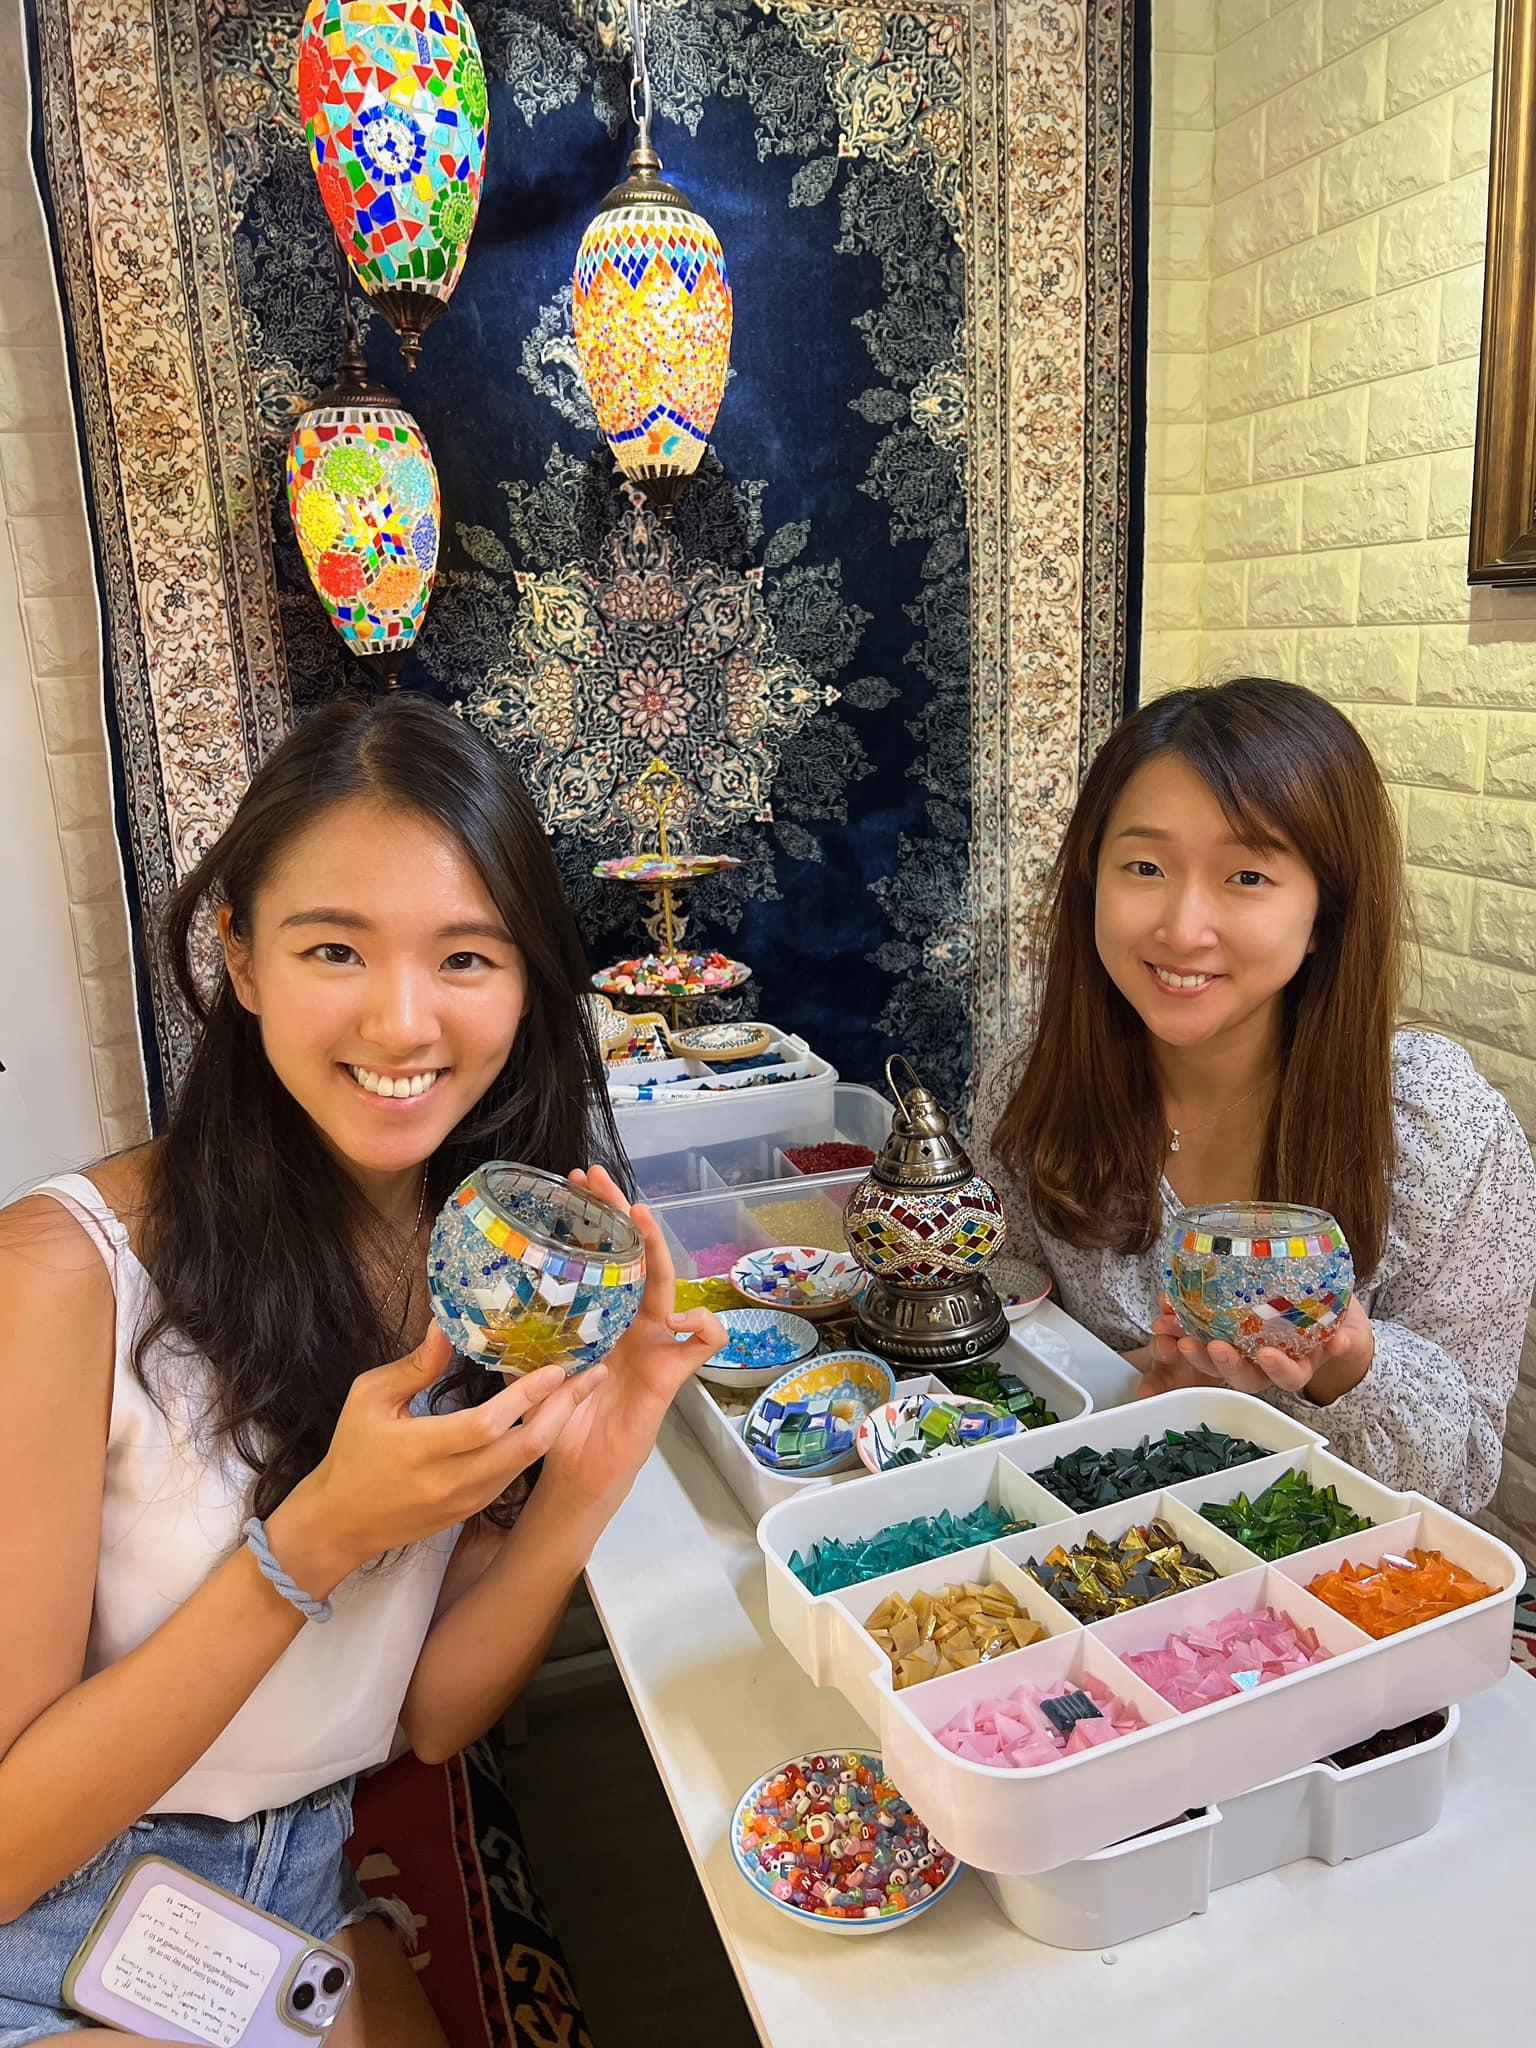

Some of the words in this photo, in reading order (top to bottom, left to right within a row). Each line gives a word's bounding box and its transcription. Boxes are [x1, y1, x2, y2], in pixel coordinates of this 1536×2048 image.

[146, 1944, 156, 1954] do
[154, 1949, 163, 1957] or
[160, 1939, 187, 1956] yourself
[162, 1953, 172, 1961] no
[171, 1956, 181, 1966] say
[185, 1952, 201, 1965] Treat
[180, 1962, 194, 1973] you
[191, 1968, 206, 1981] time
[219, 1969, 249, 1990] something
[205, 1975, 220, 1987] each
[223, 1986, 236, 1997] Fill
